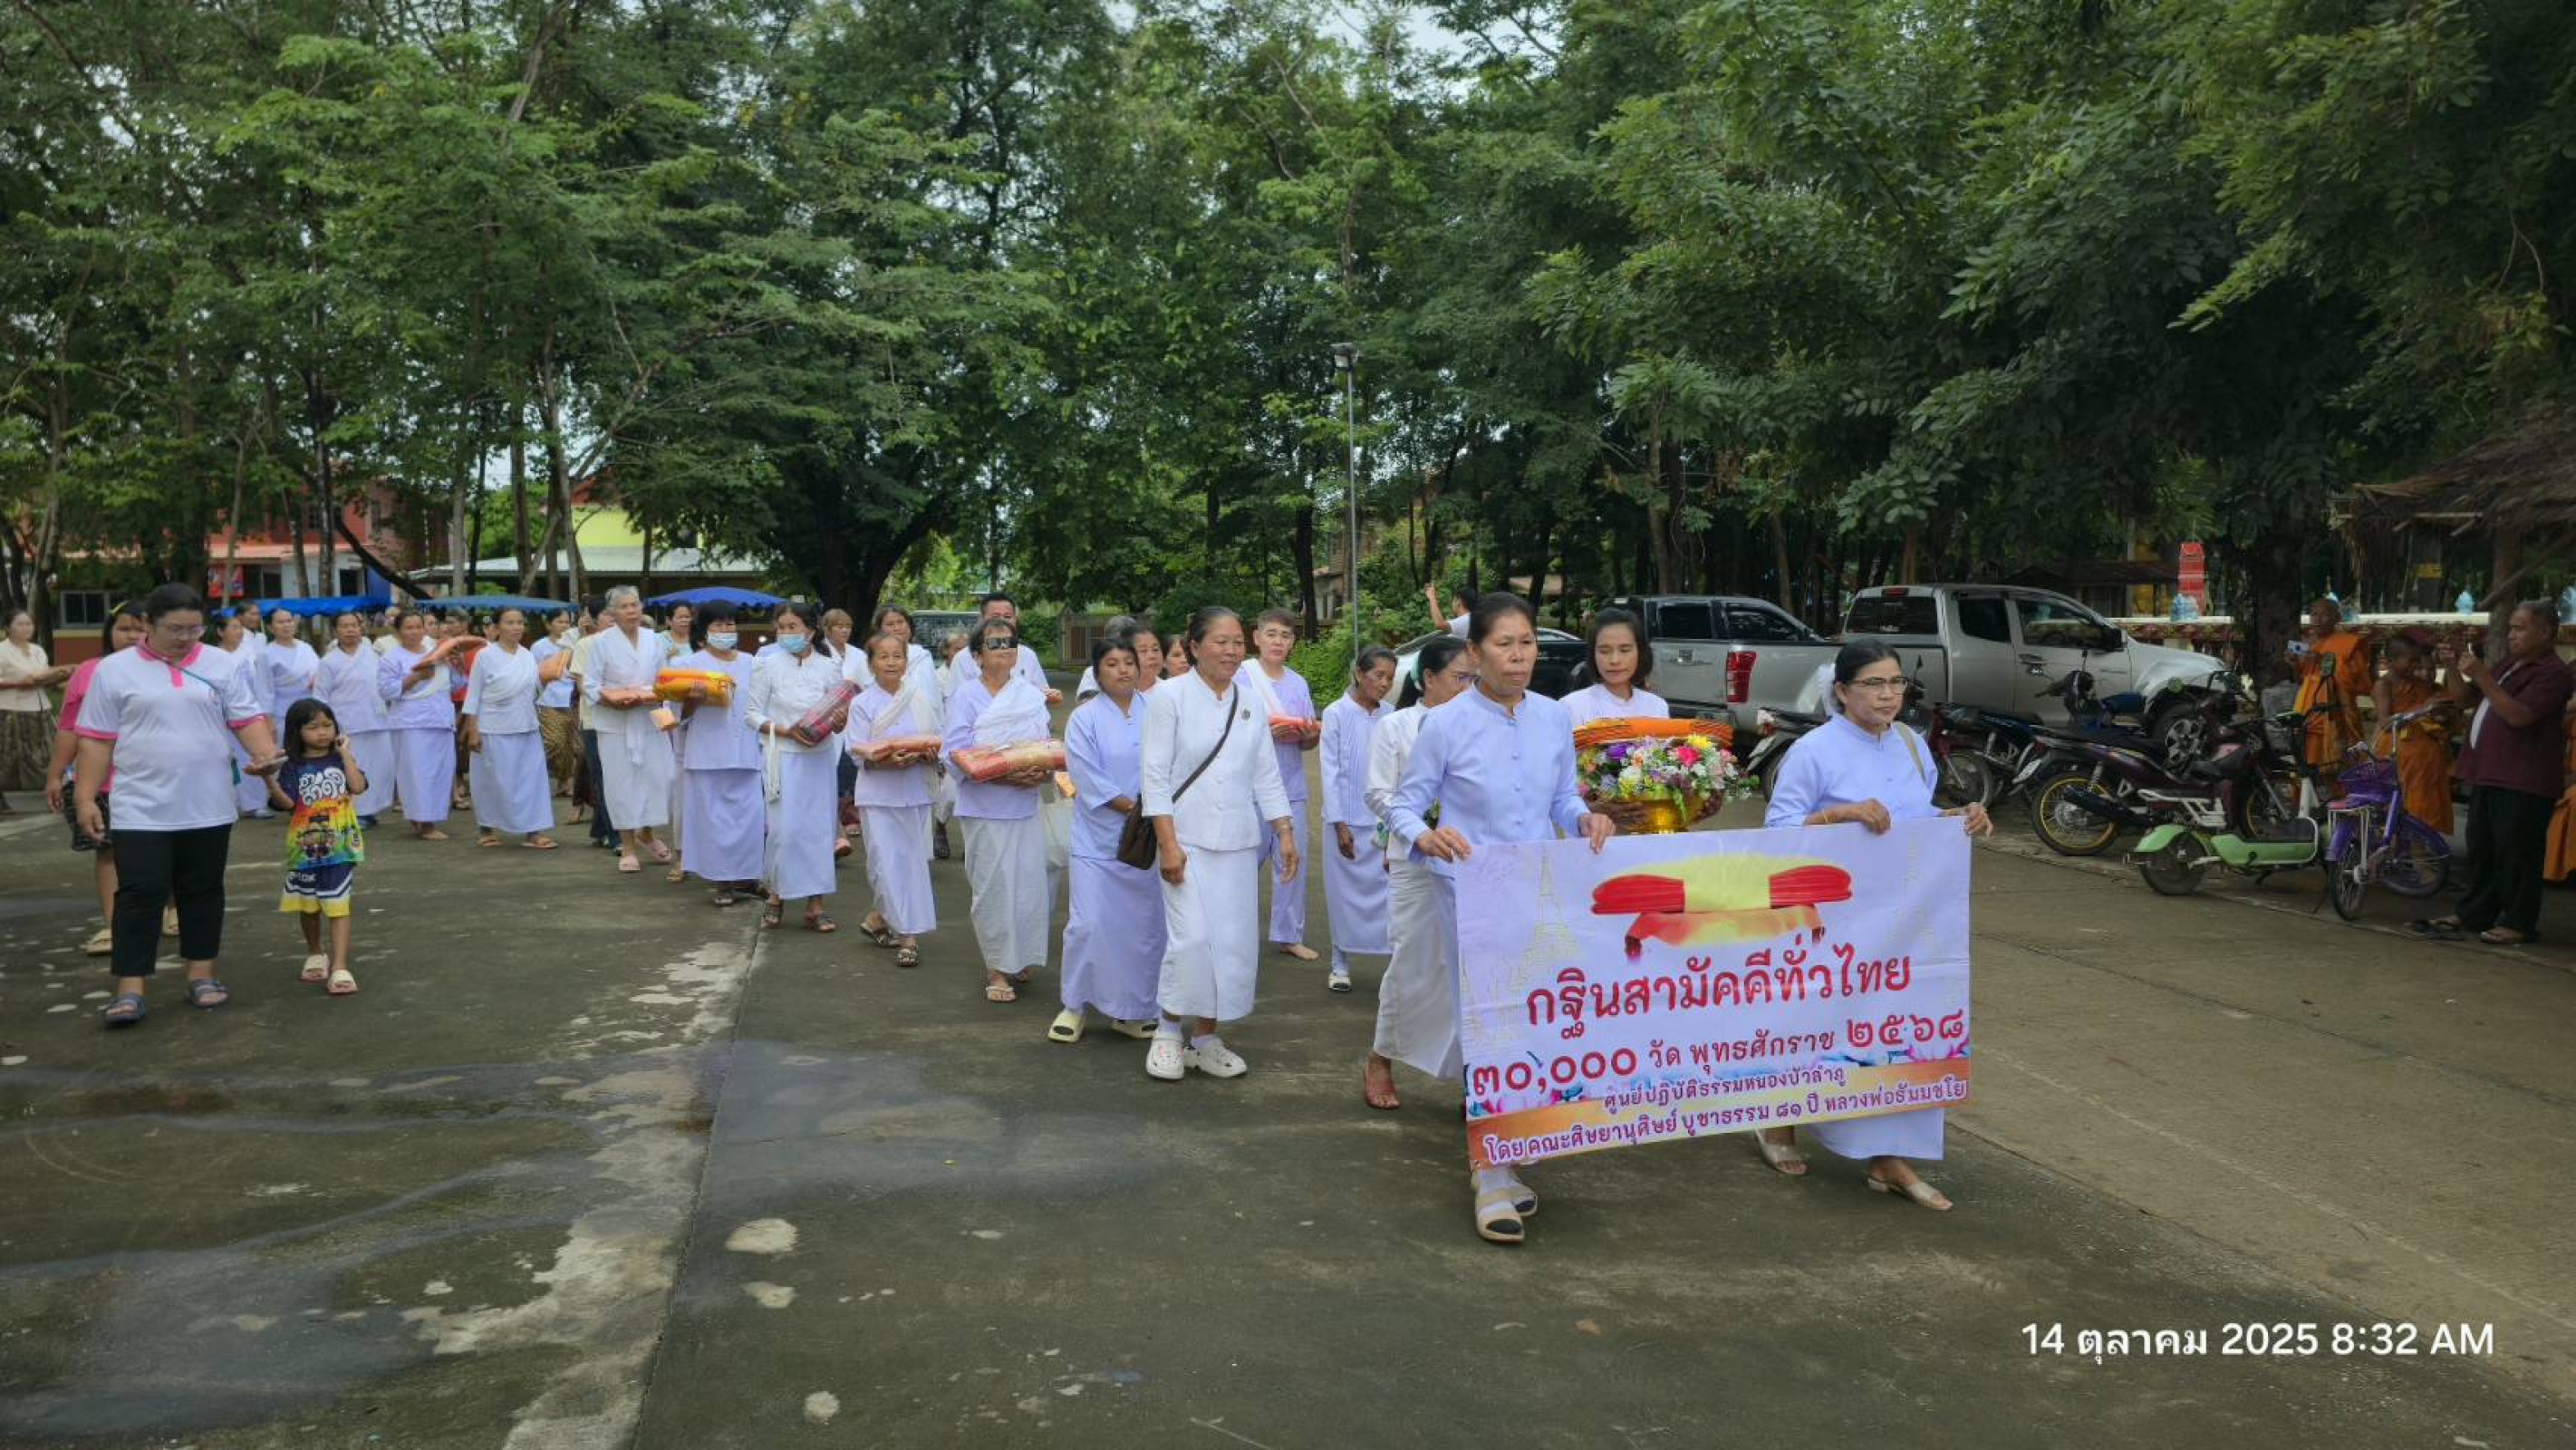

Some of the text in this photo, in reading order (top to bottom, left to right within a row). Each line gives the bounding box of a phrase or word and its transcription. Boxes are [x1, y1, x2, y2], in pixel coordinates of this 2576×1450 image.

[1527, 933, 1911, 1039] กฐินสามัคคีทั่วไทย
[1473, 1008, 1964, 1096] ๓๐,๐๐๐ วัด พุทธศักราช ๒๕๖๘
[1683, 1103, 1769, 1136] บูชาธรรม
[1807, 1092, 1819, 1114] ปี
